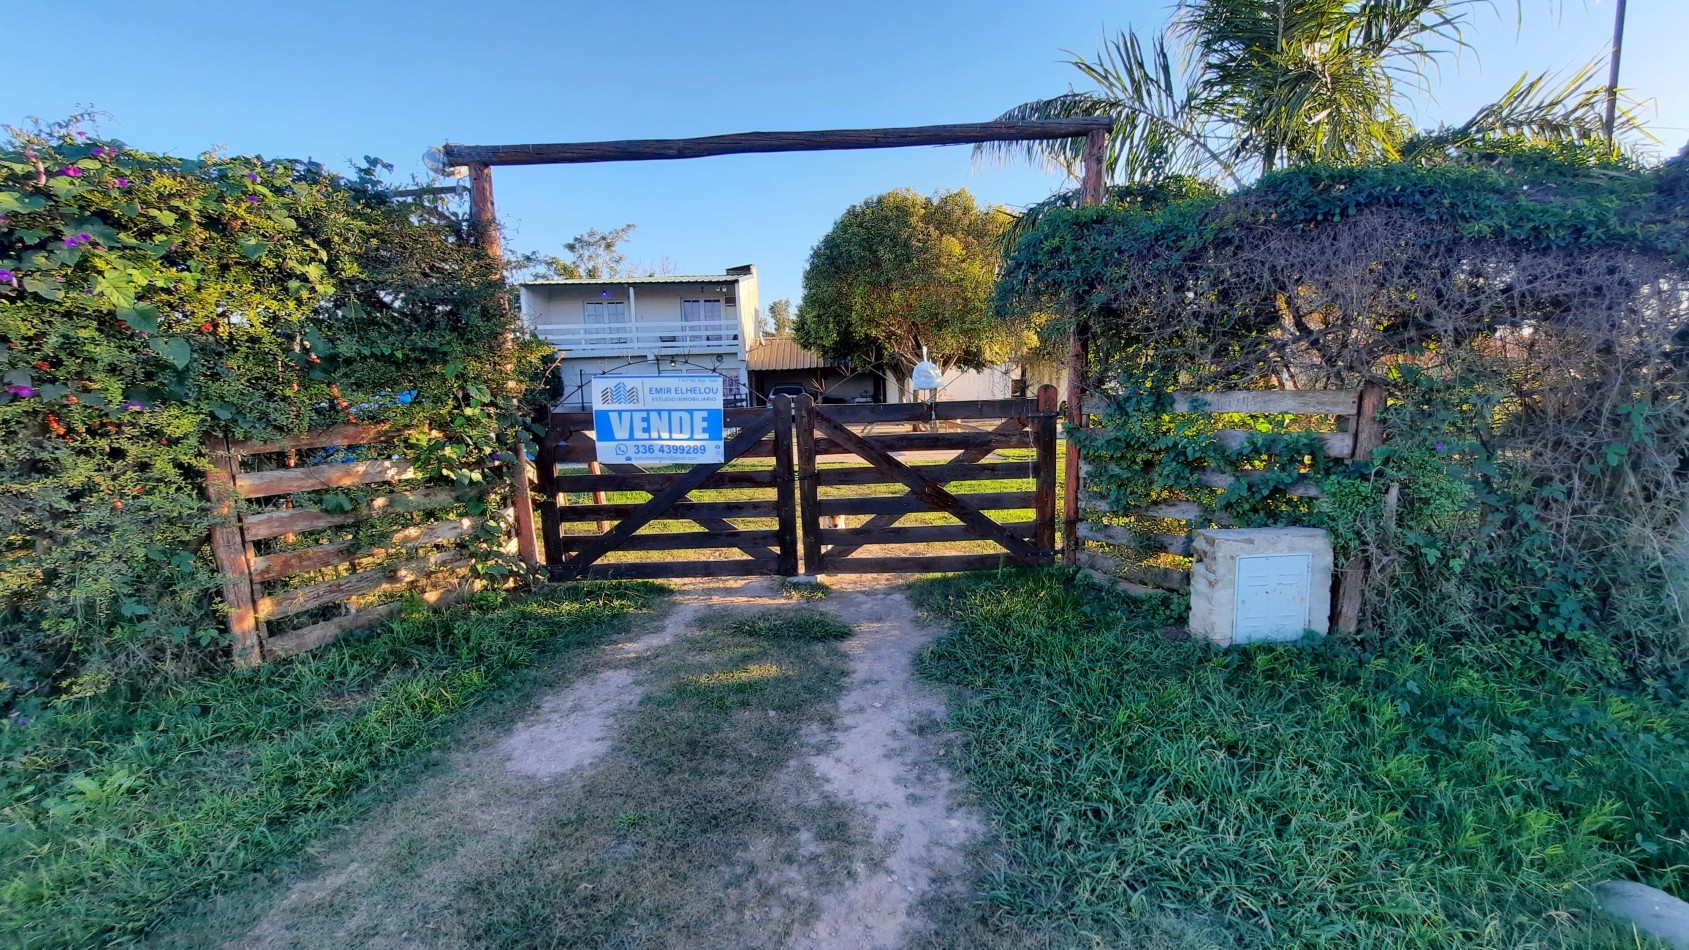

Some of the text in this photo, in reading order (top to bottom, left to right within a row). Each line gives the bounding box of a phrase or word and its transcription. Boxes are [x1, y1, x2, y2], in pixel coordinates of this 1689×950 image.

[608, 411, 709, 439] VENDE
[633, 444, 706, 455] 336 4399289
